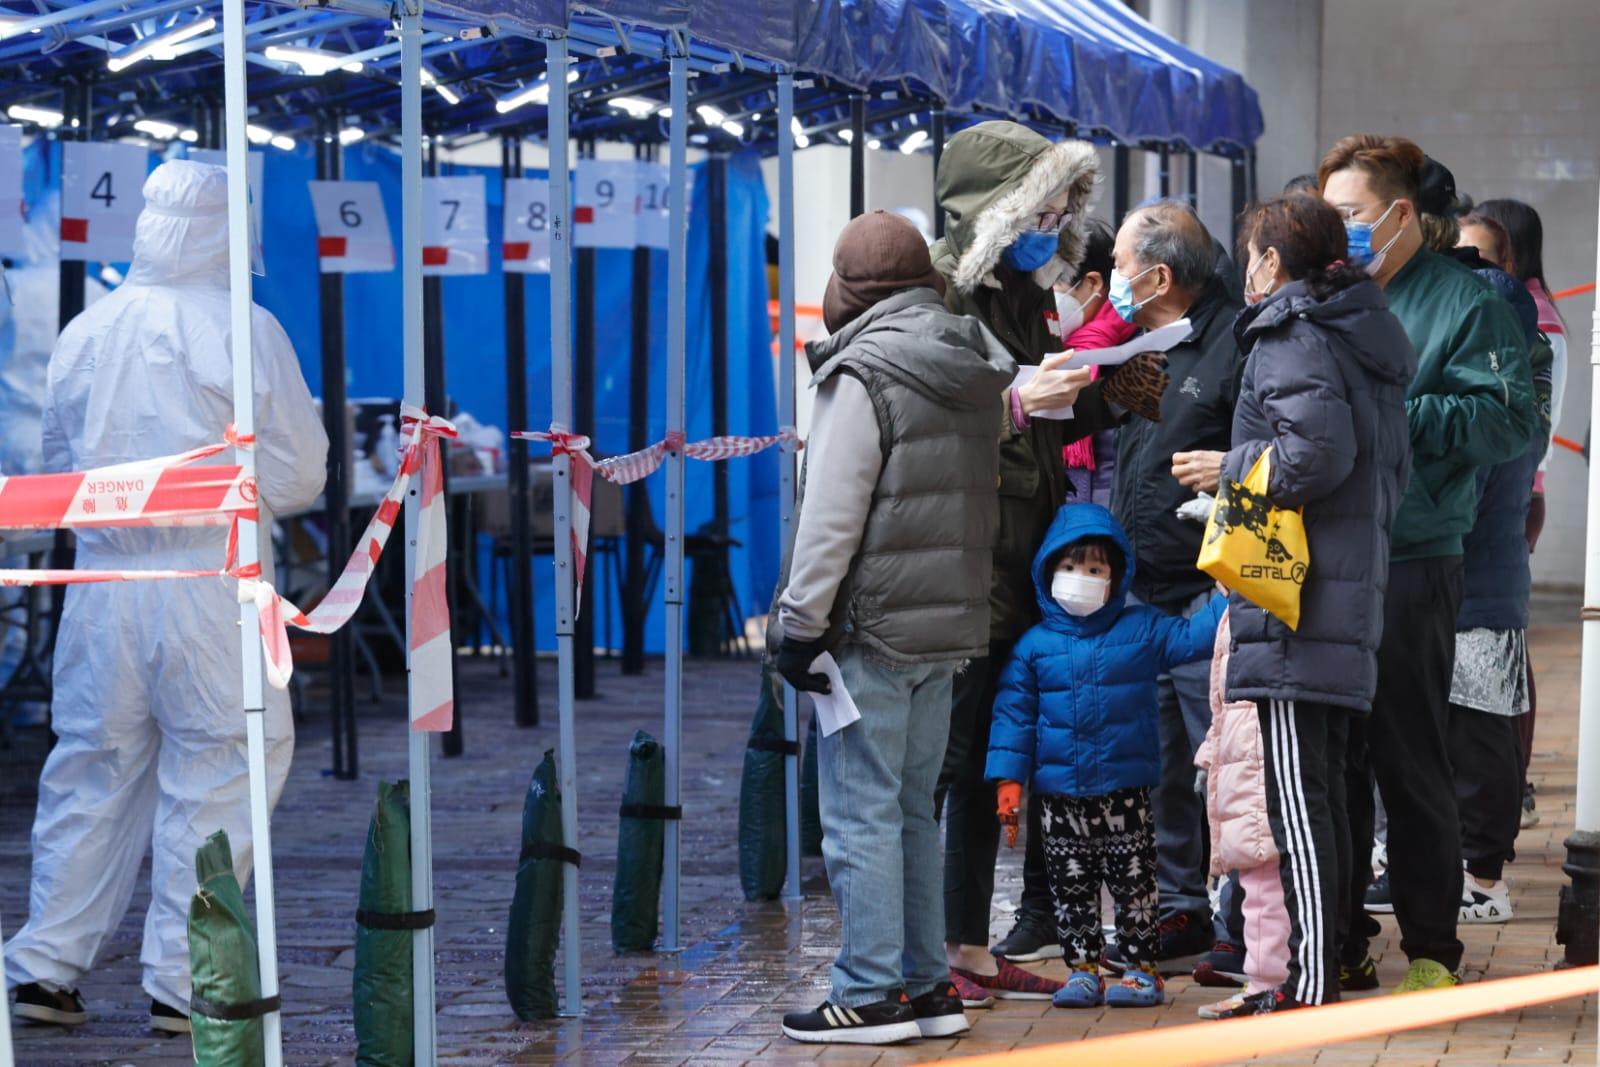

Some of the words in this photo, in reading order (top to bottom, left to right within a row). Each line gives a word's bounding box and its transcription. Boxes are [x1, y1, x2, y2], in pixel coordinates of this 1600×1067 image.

[90, 171, 116, 208] 4
[595, 180, 615, 208] 9
[339, 200, 362, 228] 6
[440, 200, 461, 230] 7
[527, 201, 546, 232] 8
[87, 479, 144, 494] DANGER
[1462, 905, 1500, 920] ILA
